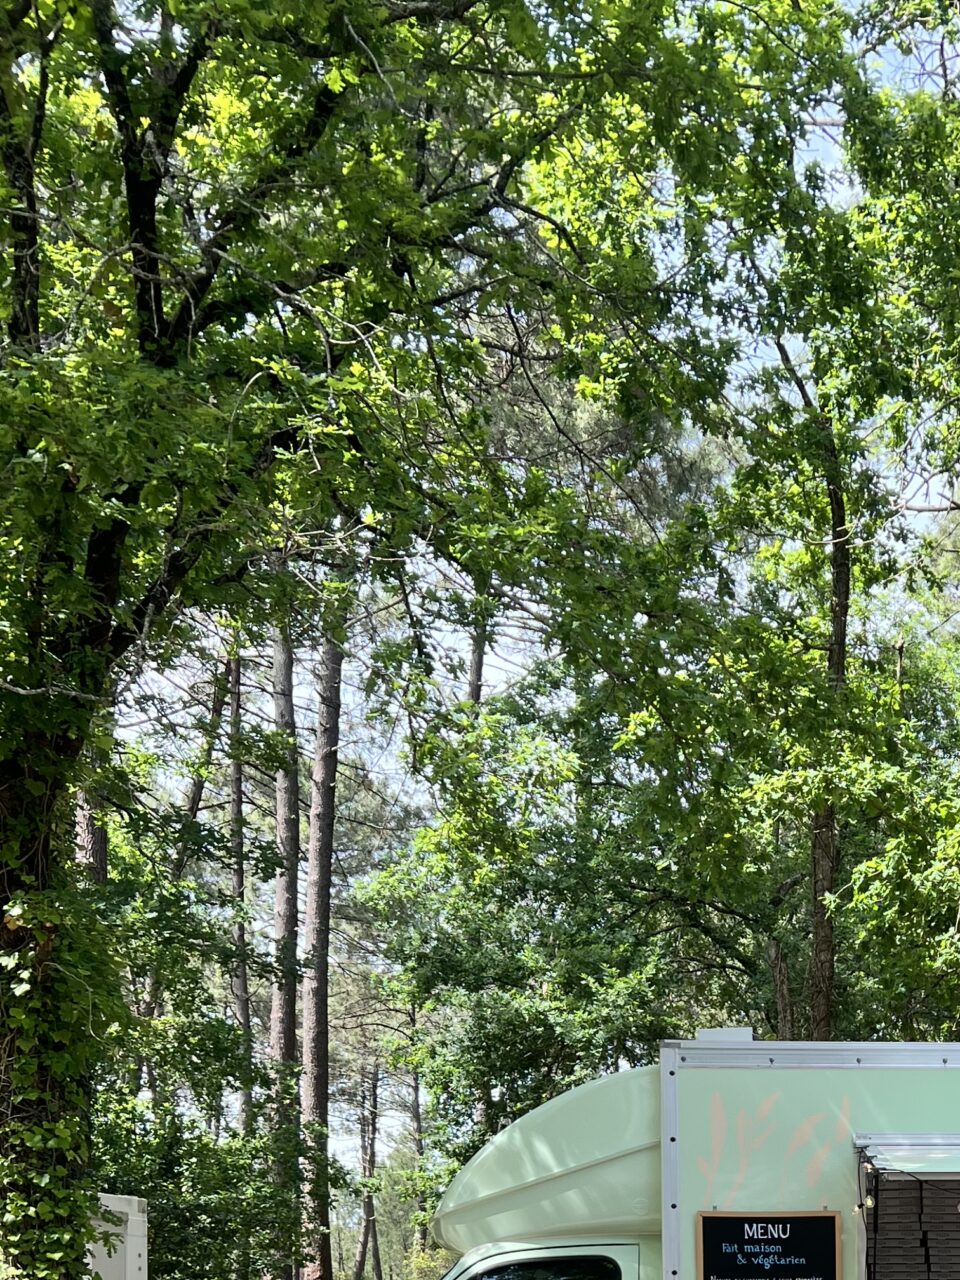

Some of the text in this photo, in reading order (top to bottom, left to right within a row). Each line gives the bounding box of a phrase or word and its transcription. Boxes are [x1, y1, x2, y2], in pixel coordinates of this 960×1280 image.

[744, 1223, 791, 1239] MENU
[722, 1242, 782, 1253] Fait maison
[736, 1254, 807, 1270] & végétarien
